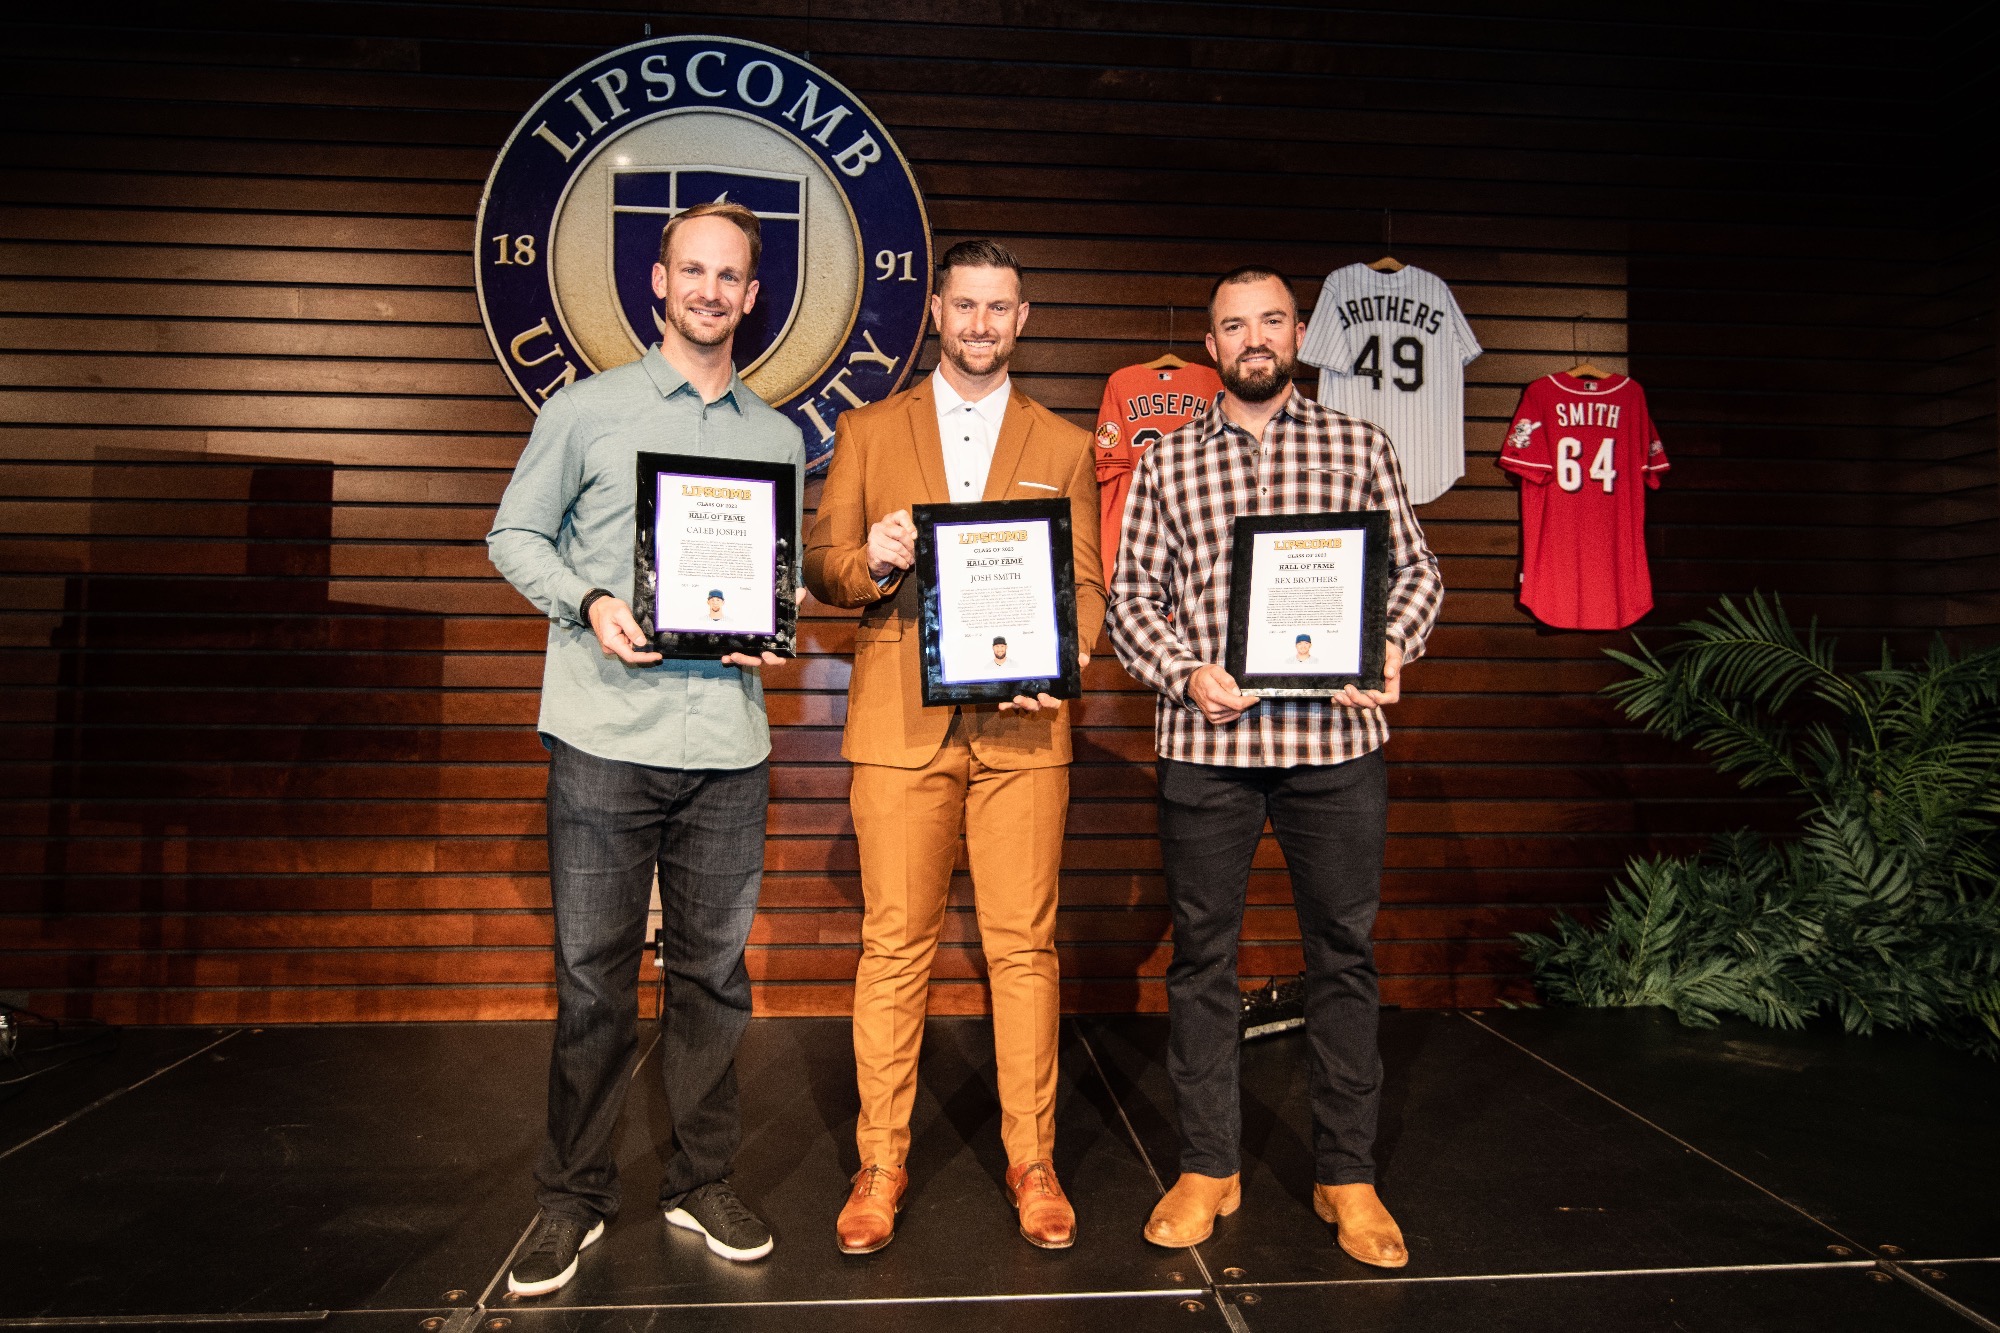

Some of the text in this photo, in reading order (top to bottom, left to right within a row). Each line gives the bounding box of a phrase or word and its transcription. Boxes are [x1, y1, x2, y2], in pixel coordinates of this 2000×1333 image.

[532, 50, 883, 178] LIPSCOMB
[492, 233, 536, 266] 18
[875, 249, 918, 282] 91
[1354, 335, 1424, 392] 49
[1126, 393, 1209, 421] JOSEPH
[1555, 402, 1621, 429] SMITH
[1556, 436, 1617, 494] 64
[682, 485, 751, 500] LIPSCOMB
[689, 512, 709, 520] HALL
[723, 514, 746, 522] FAME
[686, 526, 747, 537] CALEB JOSEPH
[958, 530, 1028, 544] LIPSCOMB
[1274, 538, 1342, 550] LIPSCOMB
[966, 557, 1024, 567] HALL OF FAME
[970, 572, 1021, 584] JOSH SMITH
[1293, 575, 1338, 584] BROTHERS
